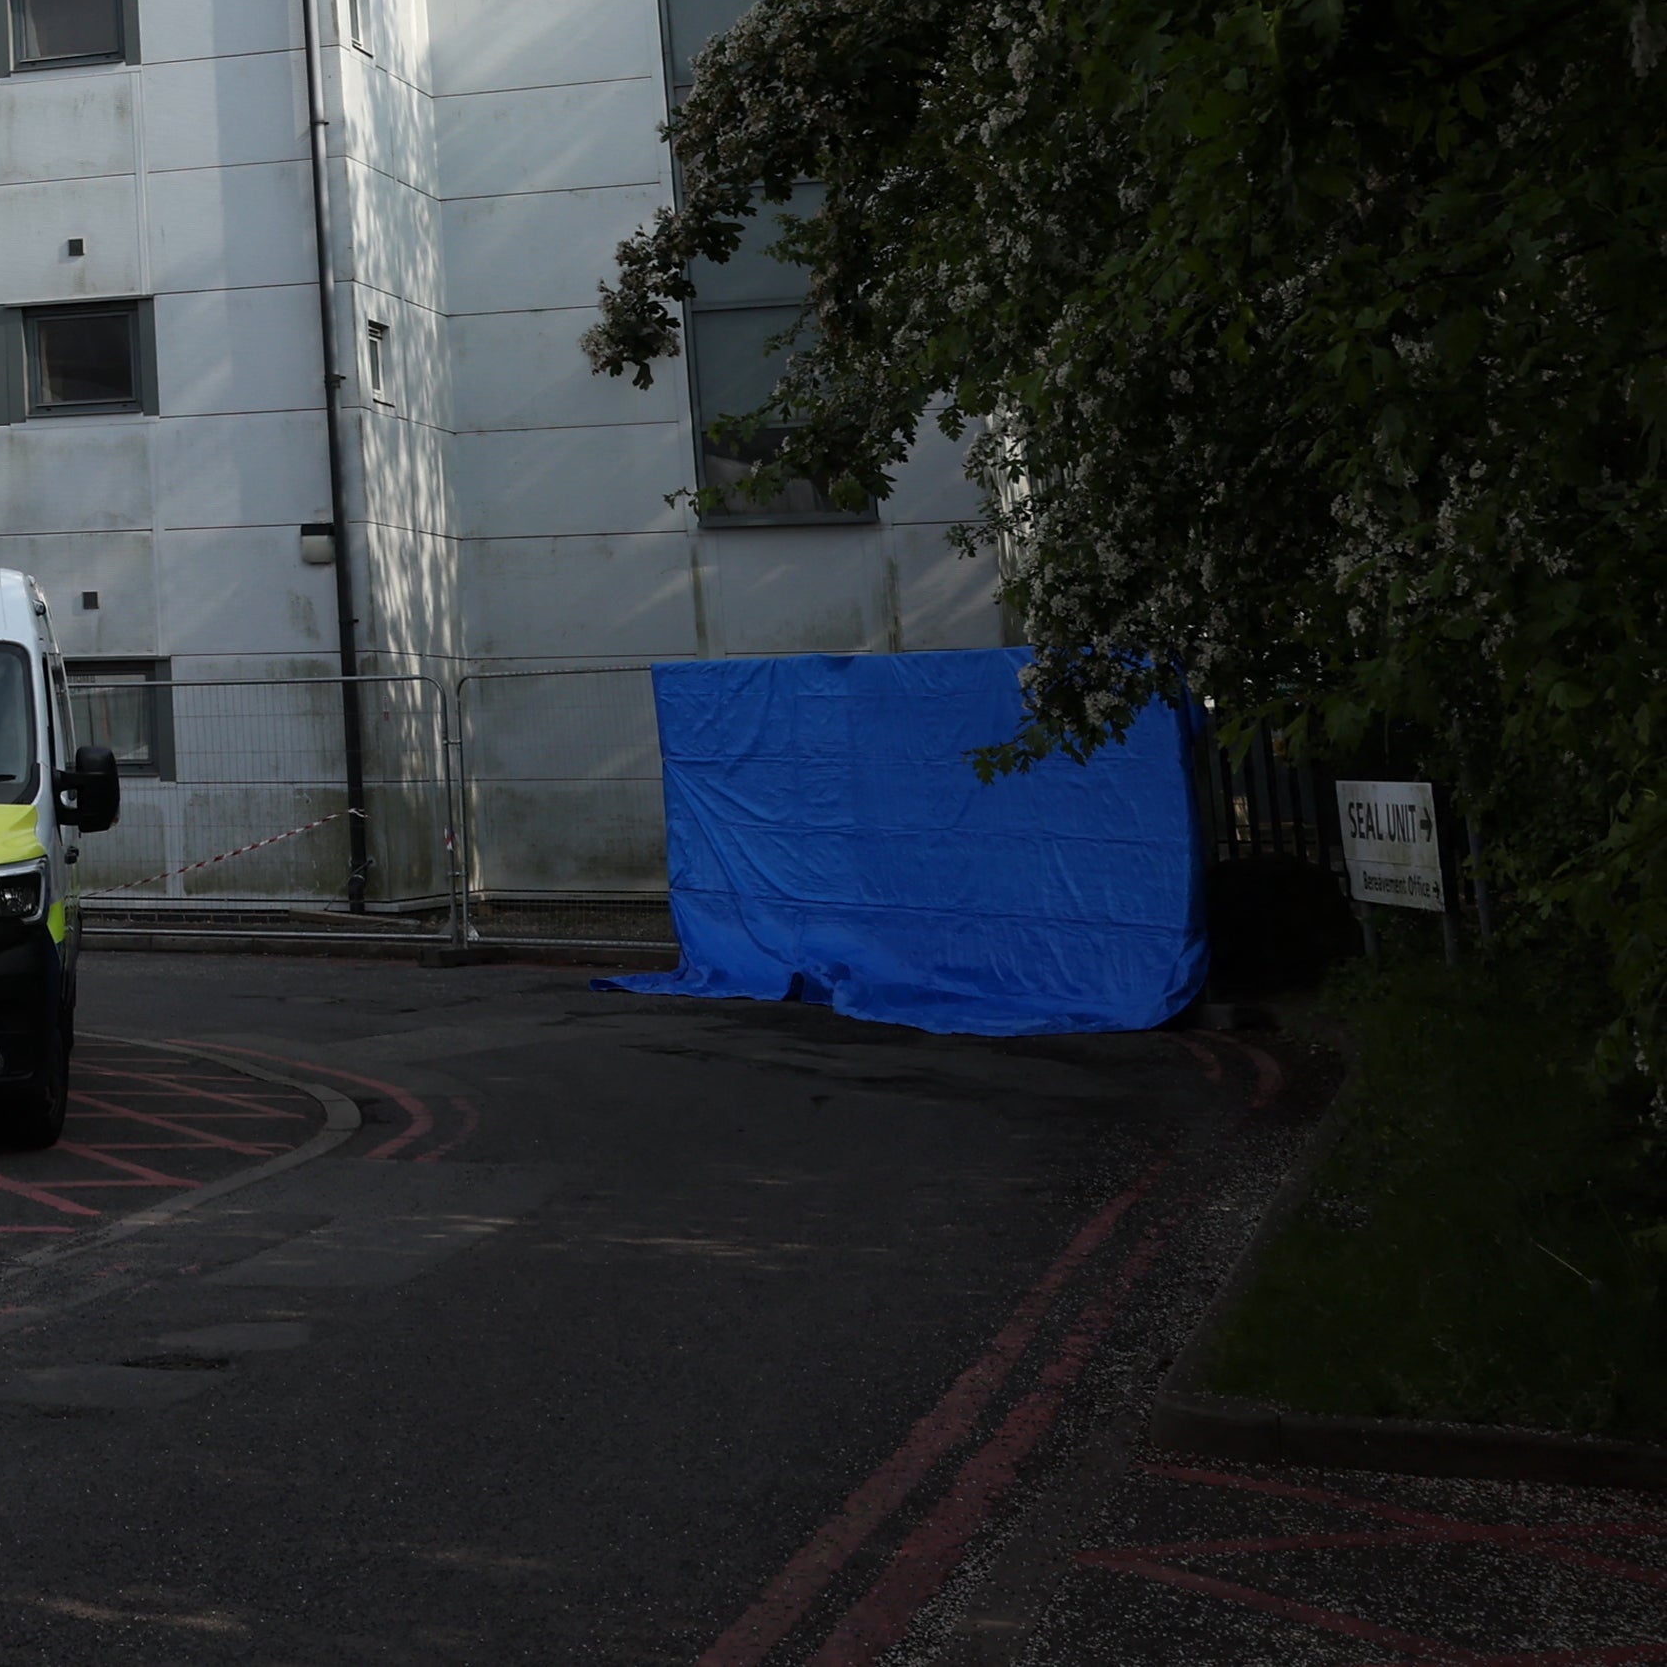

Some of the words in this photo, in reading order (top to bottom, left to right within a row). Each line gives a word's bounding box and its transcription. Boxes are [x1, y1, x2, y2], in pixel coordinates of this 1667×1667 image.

[1348, 802, 1383, 840] SEAL
[1386, 802, 1416, 843] UNIT
[1363, 870, 1406, 895] Bereavement
[1407, 875, 1431, 898] Office
